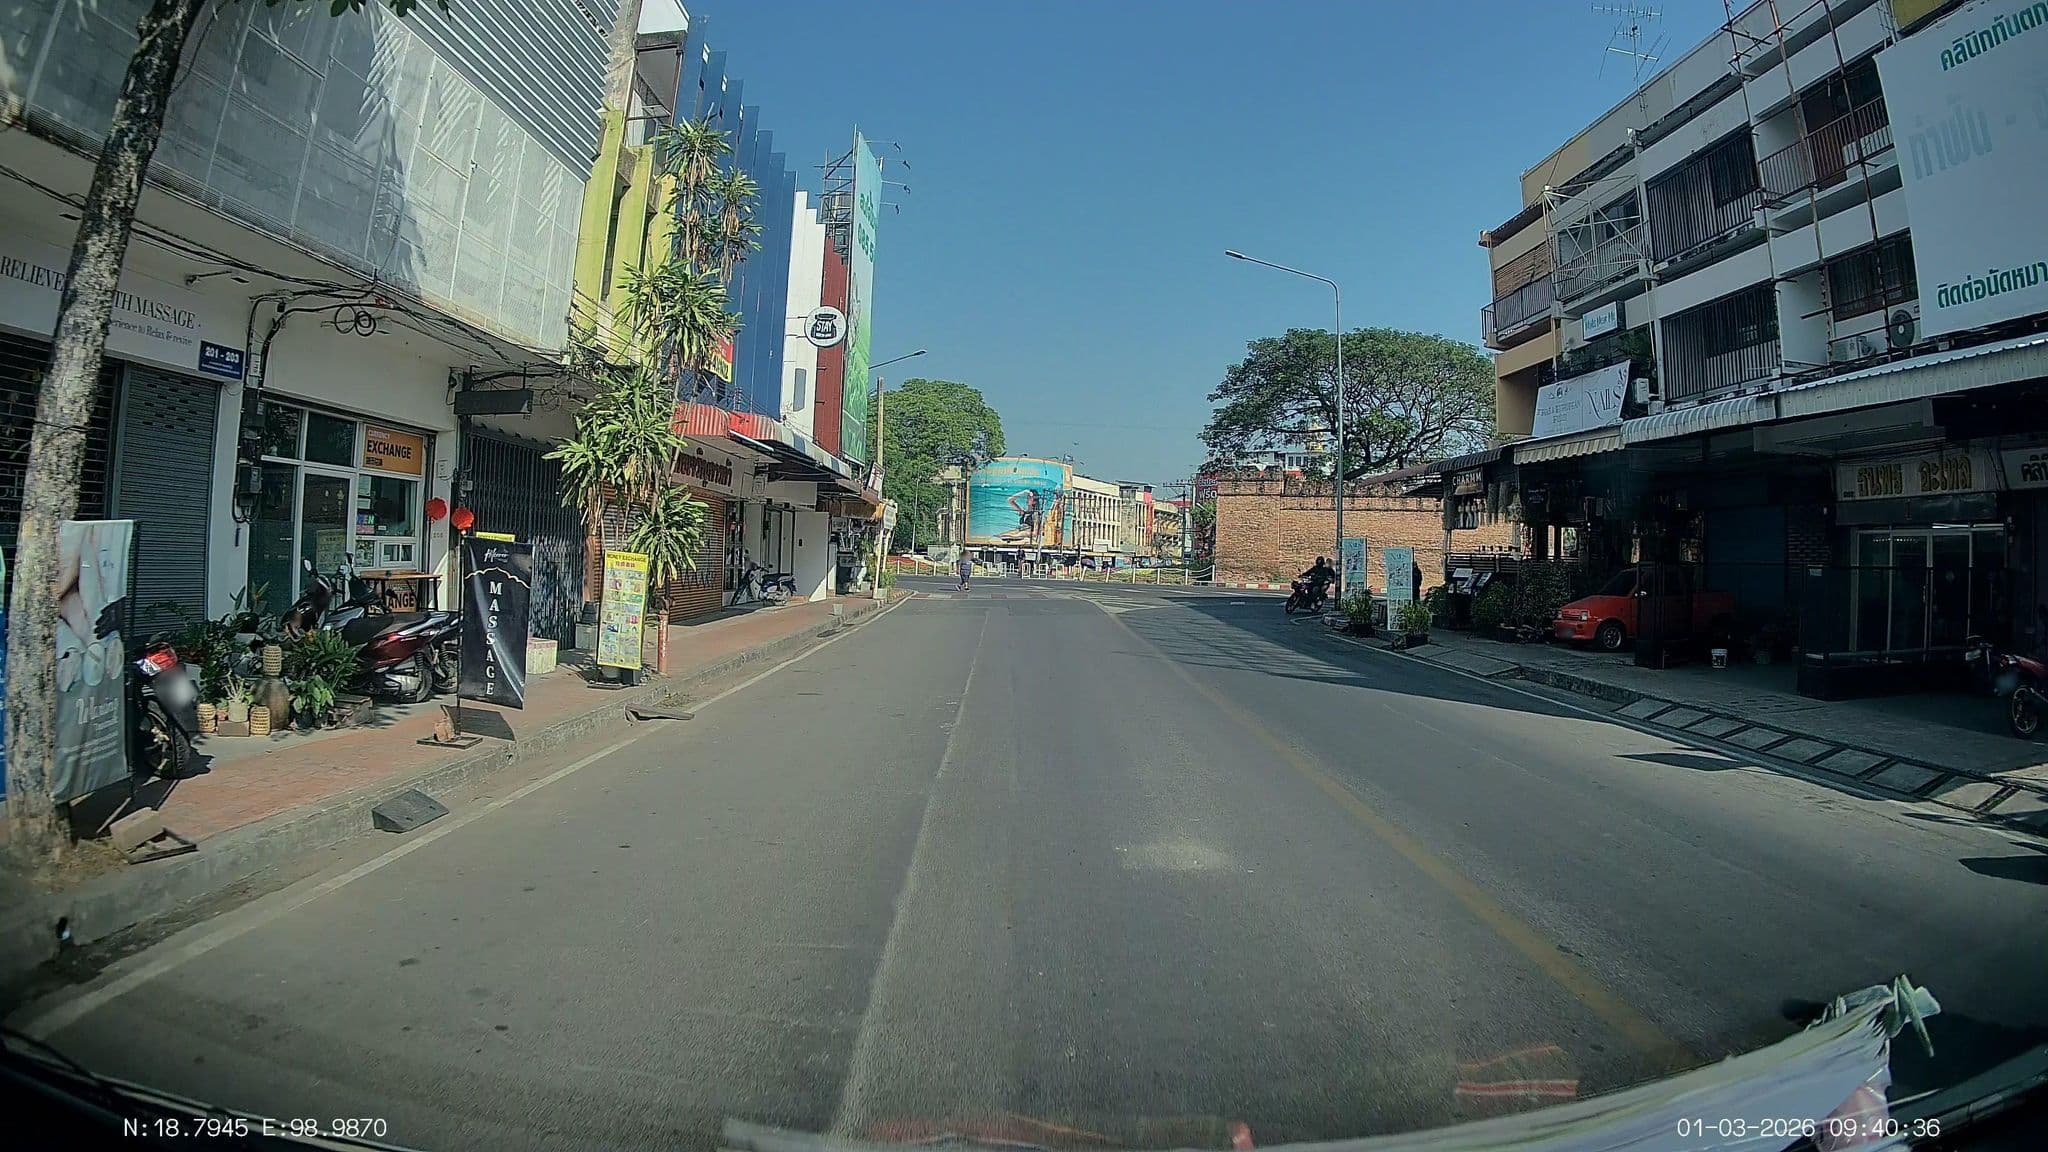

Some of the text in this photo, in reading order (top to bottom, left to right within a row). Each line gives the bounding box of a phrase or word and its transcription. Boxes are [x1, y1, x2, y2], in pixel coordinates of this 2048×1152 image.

[135, 297, 196, 330] MASSAGE
[816, 320, 833, 333] STAY
[205, 346, 219, 359] 201
[225, 352, 240, 364] 203
[366, 440, 412, 460] EXCHANGE
[486, 582, 502, 695] MASSAGE
